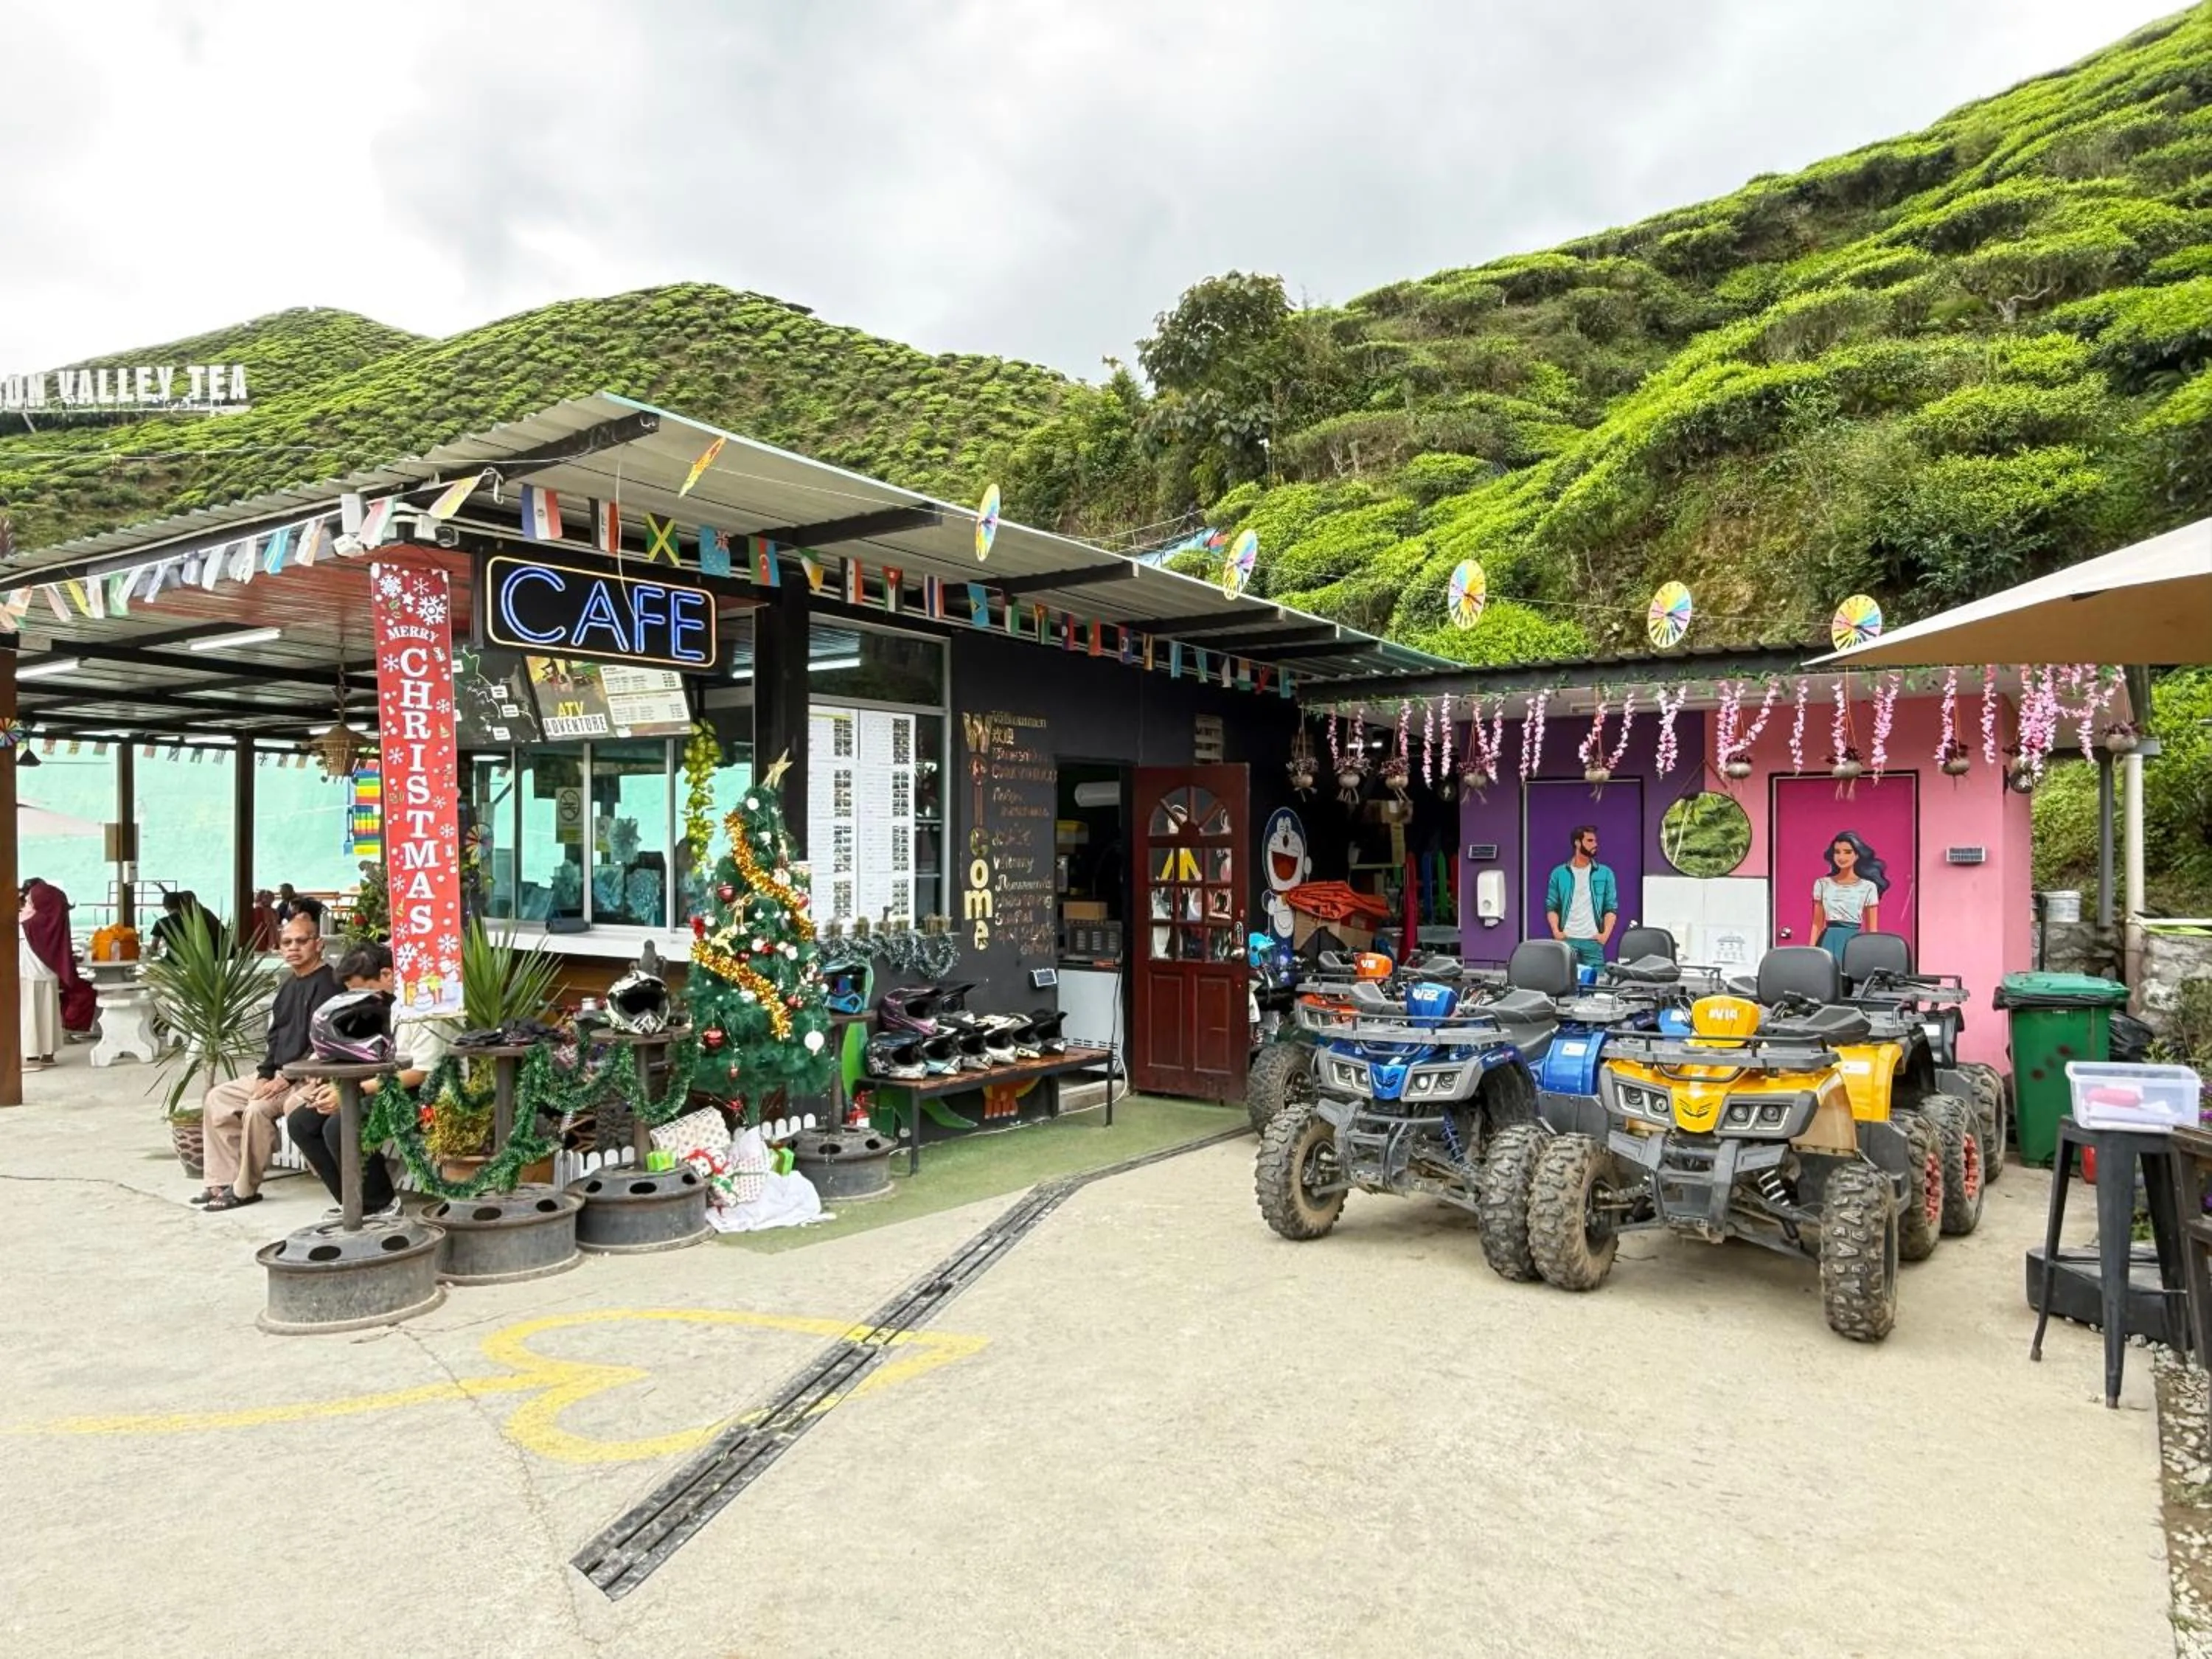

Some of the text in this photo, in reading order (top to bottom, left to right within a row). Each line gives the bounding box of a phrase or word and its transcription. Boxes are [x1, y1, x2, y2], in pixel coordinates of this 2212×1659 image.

[58, 366, 174, 403] VALLEY
[187, 365, 247, 400] TEA
[501, 566, 706, 661] CAFE
[386, 625, 439, 644] MERRY
[557, 701, 584, 717] ATV
[543, 716, 608, 734] ADVENTURE
[399, 647, 439, 935] CHRISTMAS
